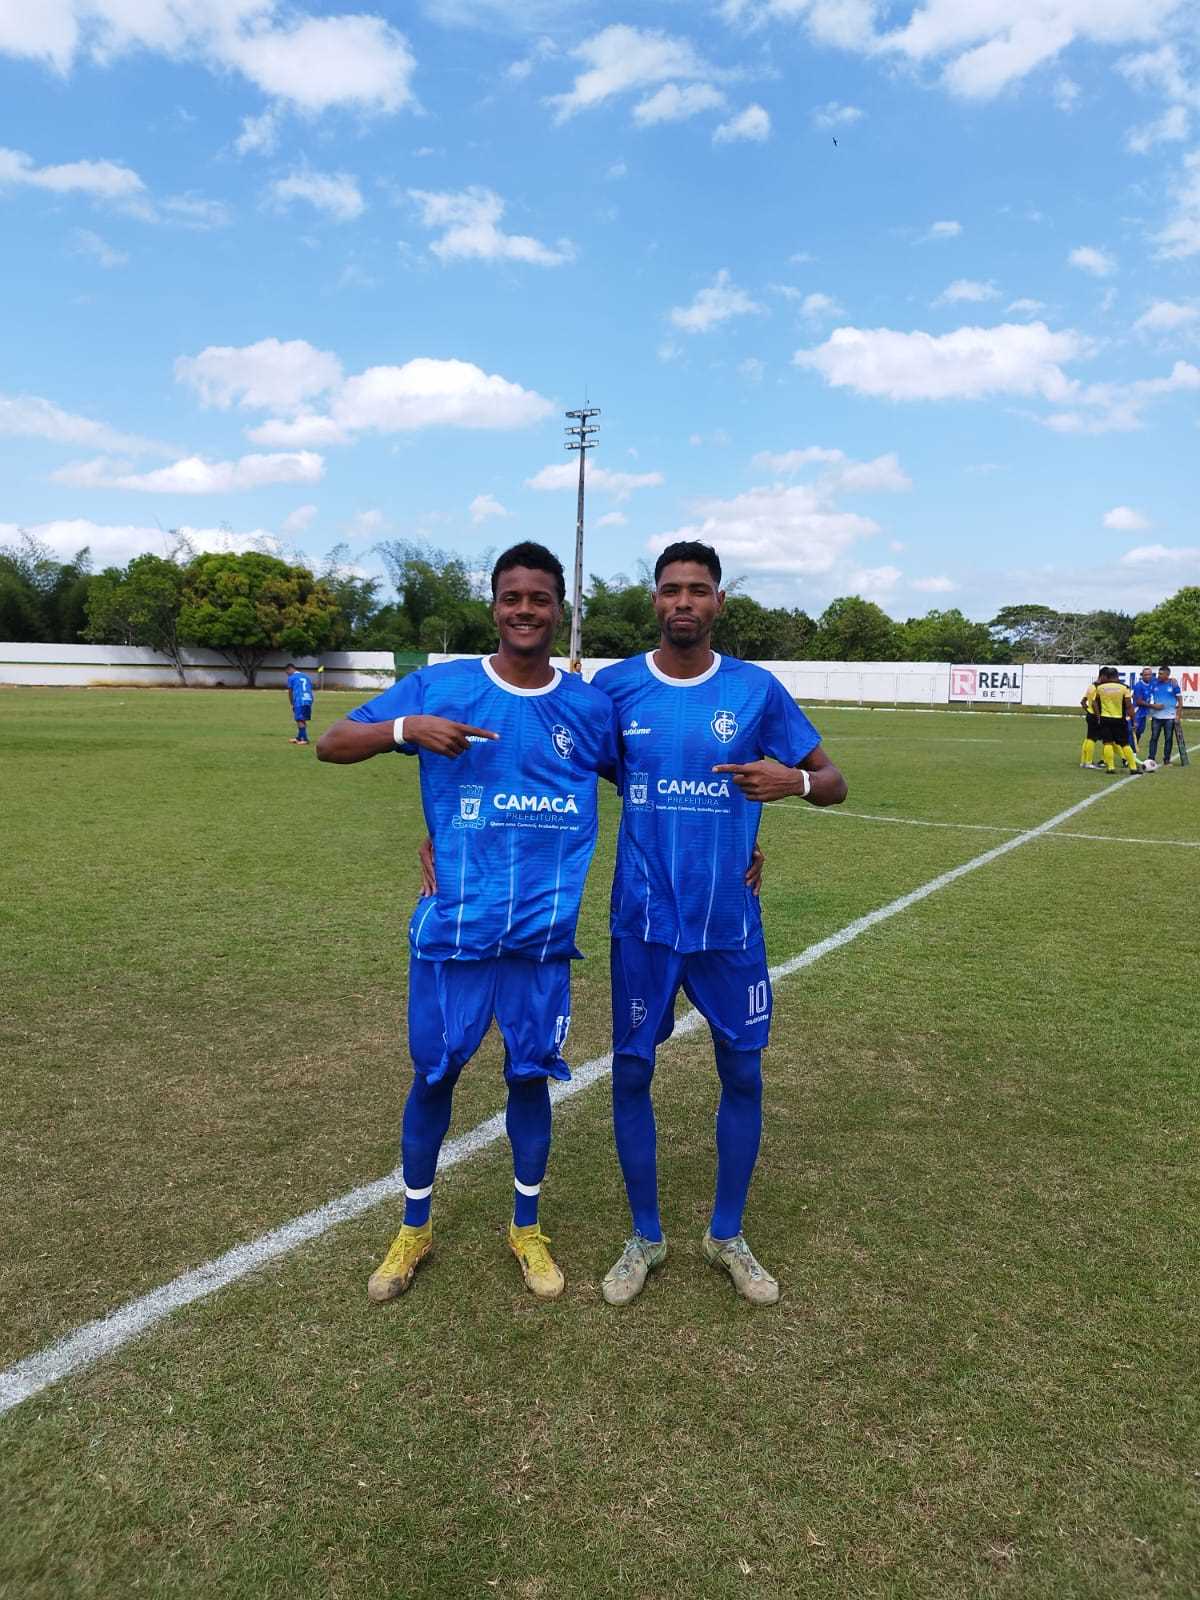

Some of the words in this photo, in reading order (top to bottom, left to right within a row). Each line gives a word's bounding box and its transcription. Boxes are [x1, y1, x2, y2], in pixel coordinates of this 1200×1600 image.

[299, 678, 307, 691] 7
[979, 672, 1020, 689] REAL
[657, 779, 730, 798] CAMACÃ
[493, 793, 579, 814] CAMACÃ
[667, 795, 720, 807] PREFEITURA
[506, 812, 564, 823] PREFEITURA
[747, 980, 768, 1017] 10
